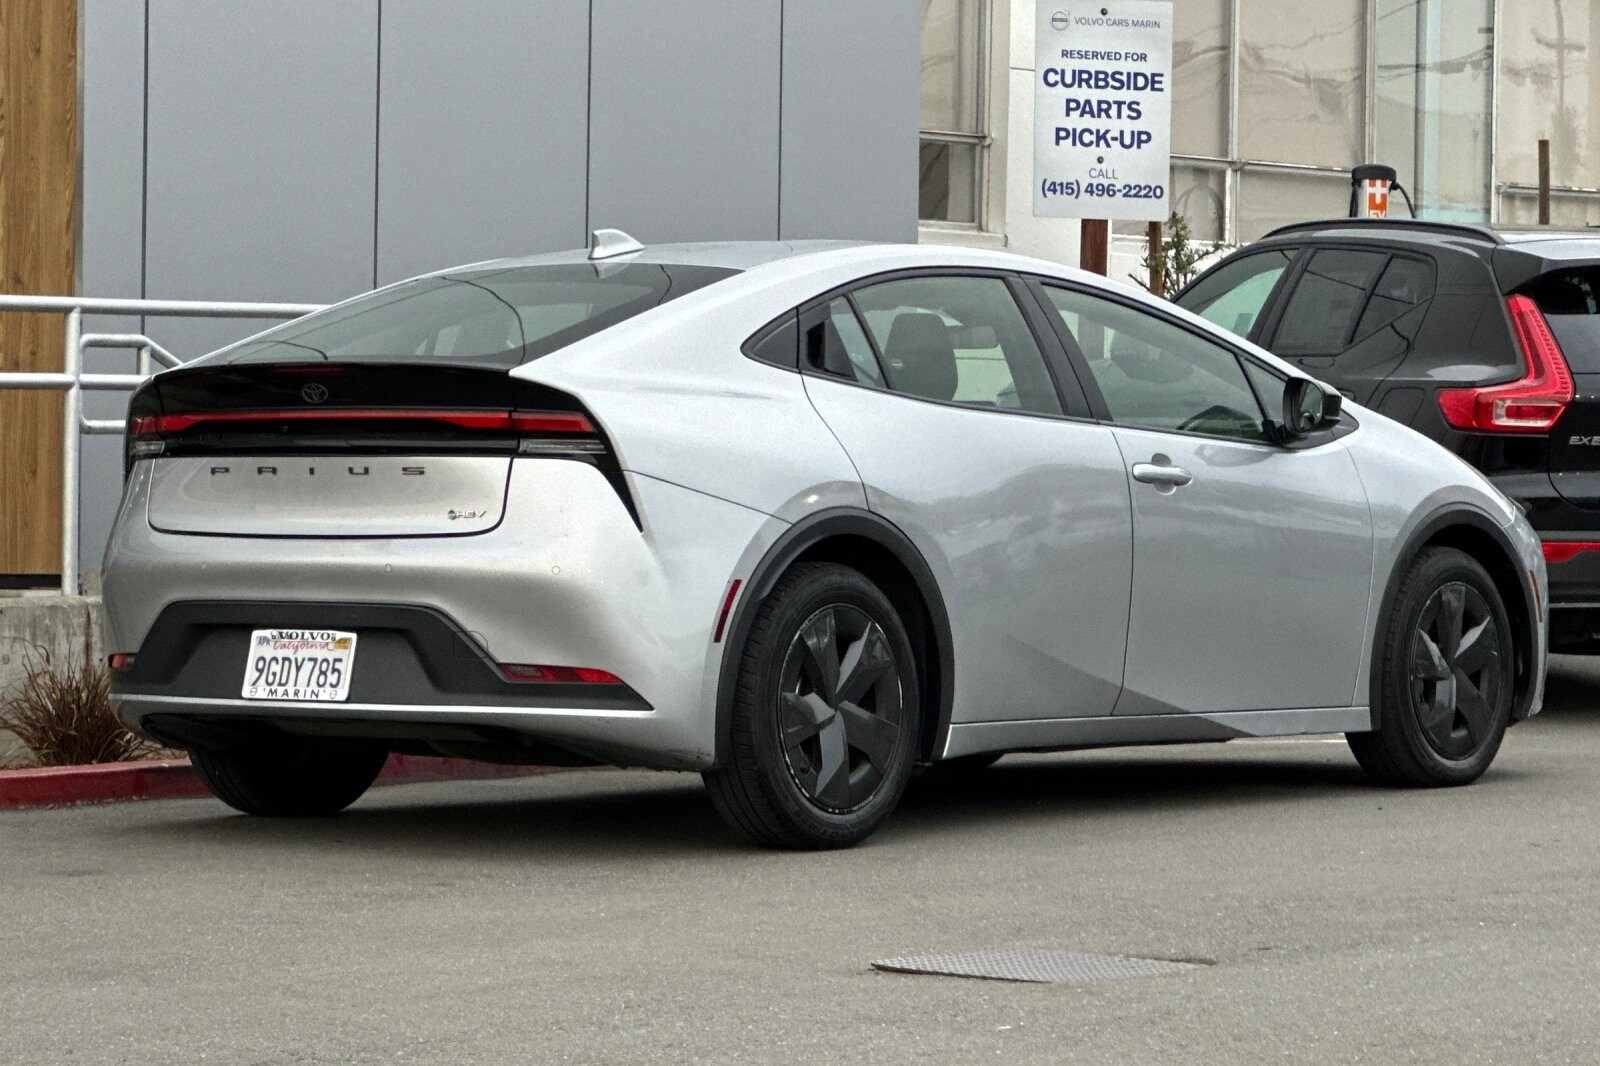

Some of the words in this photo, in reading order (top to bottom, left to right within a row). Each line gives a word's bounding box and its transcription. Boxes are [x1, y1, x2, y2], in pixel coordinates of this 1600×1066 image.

[1074, 16, 1104, 26] VOLVO
[1105, 18, 1130, 27] CARS
[1131, 19, 1161, 29] MARIN
[1061, 49, 1122, 61] RESERVED
[1124, 52, 1148, 62] FOR
[1042, 67, 1165, 92] CURBSIDE
[1065, 98, 1142, 121] PARTS
[1054, 127, 1152, 149] PICK-UP
[1088, 168, 1119, 180] CALL
[1041, 178, 1081, 199] (415)
[1084, 183, 1164, 199] 496-2220
[210, 466, 425, 475] PRIUS
[278, 631, 331, 641] VOLVO
[272, 641, 329, 655] California
[251, 656, 343, 688] 9GDY785
[267, 688, 320, 699] MARIN
